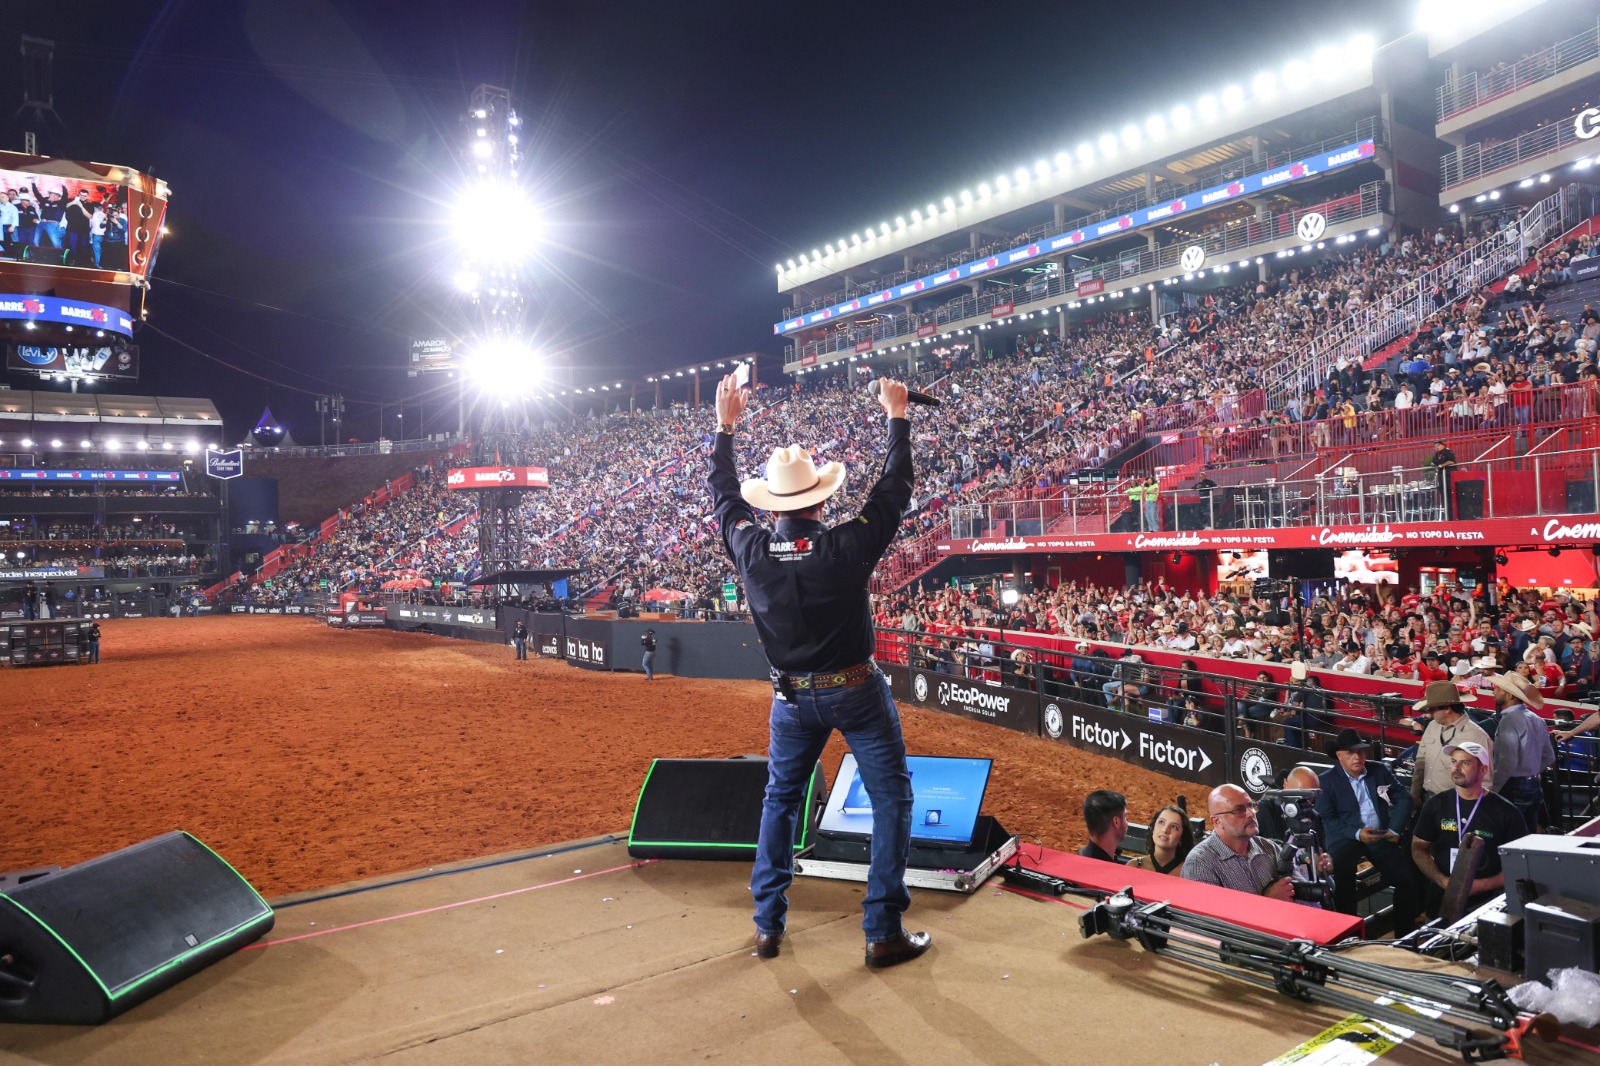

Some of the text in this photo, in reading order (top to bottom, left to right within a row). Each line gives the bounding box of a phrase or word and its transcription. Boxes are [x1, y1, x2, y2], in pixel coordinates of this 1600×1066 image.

[1080, 282, 1100, 294] BRAHMA
[412, 339, 447, 348] AMAROK
[1135, 531, 1209, 548] Cremosidade
[1319, 525, 1403, 545] Cremosidade
[1457, 531, 1484, 540] FESTA
[1531, 528, 1538, 536] A
[567, 638, 603, 662] ha ha ha
[951, 683, 1010, 713] EcoPower
[963, 705, 996, 717] ENERGIA SOLAR
[1072, 715, 1119, 750] Fictor
[1139, 732, 1197, 771] Fictor
